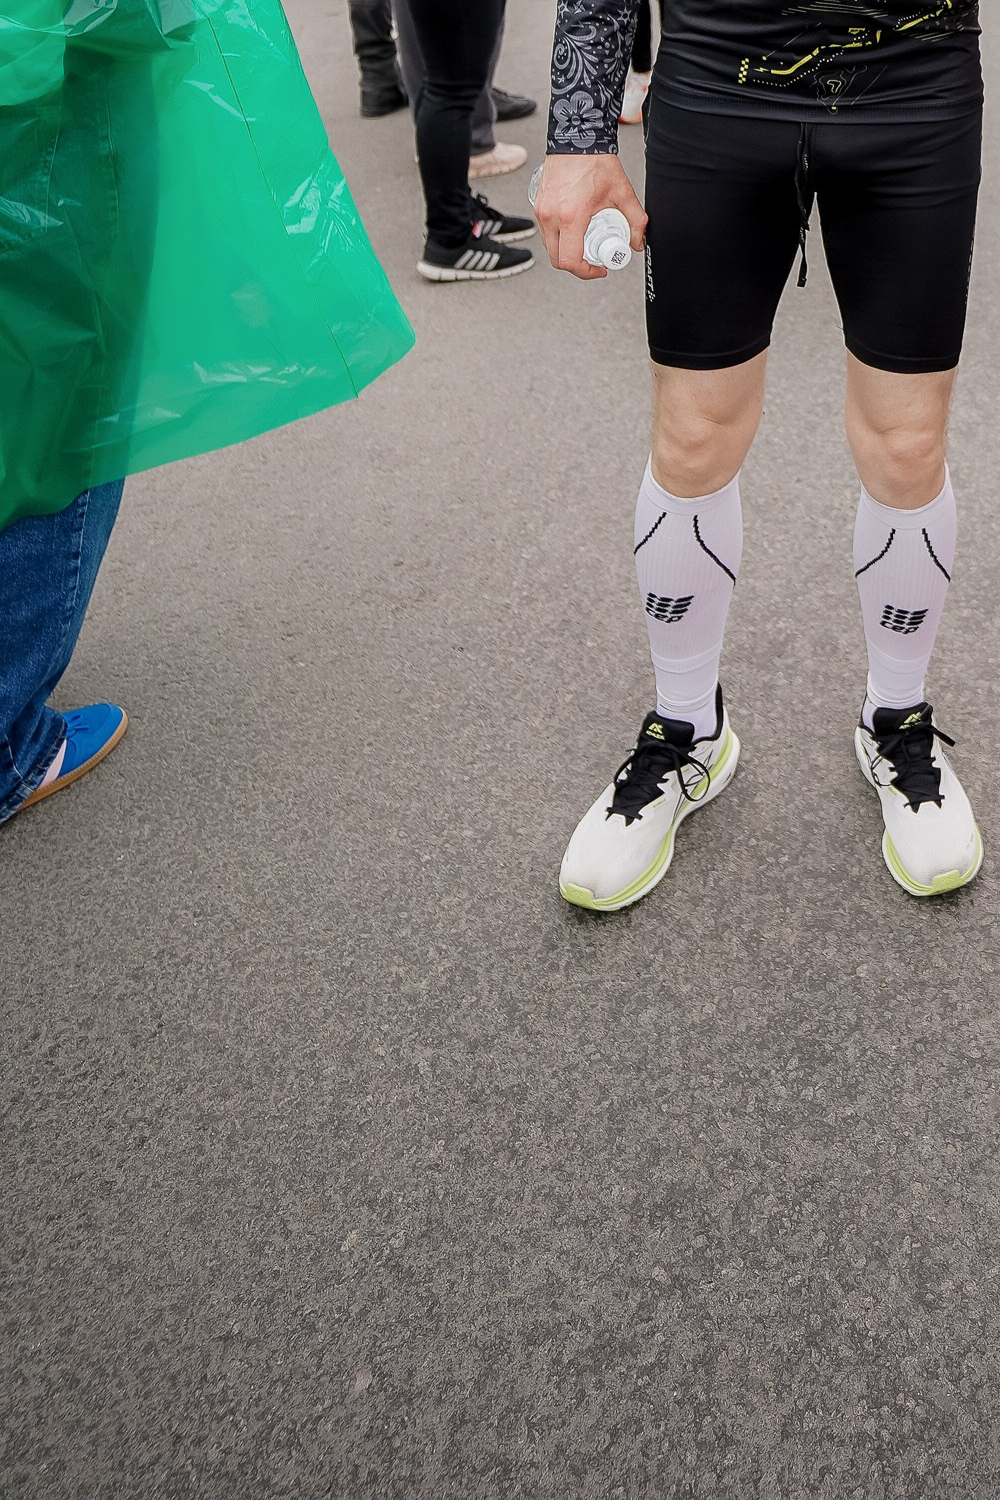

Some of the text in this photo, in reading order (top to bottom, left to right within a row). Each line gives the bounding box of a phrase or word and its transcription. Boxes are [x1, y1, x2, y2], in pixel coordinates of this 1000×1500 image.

[646, 244, 655, 292] CRAFT
[645, 606, 684, 624] cep
[879, 619, 920, 635] cep
